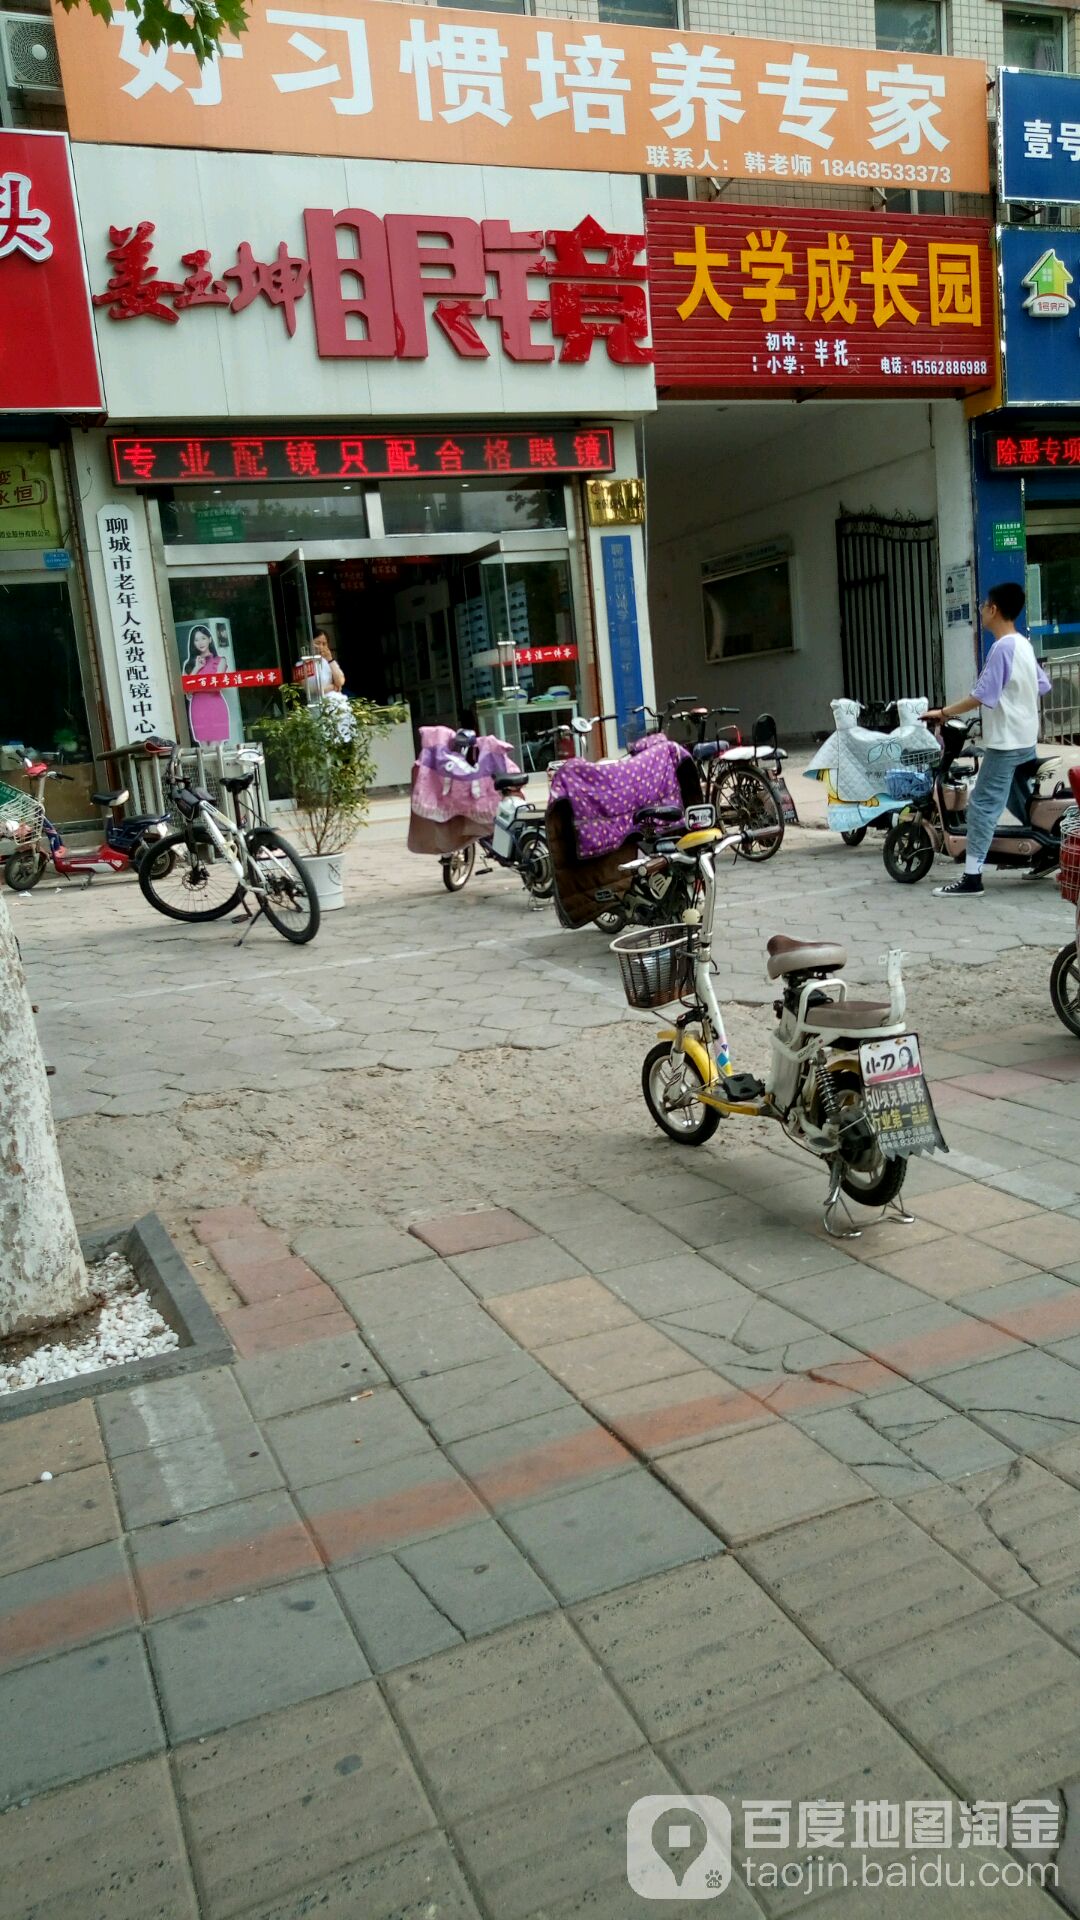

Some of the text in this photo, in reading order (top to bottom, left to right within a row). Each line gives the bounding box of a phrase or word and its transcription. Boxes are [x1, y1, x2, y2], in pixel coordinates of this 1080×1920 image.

[1024, 119, 1080, 161] 壹号
[744, 151, 812, 177] 韩老师
[820, 158, 951, 184] 18463533373
[673, 226, 982, 328] 大学成长园
[814, 338, 849, 368] 半托
[123, 435, 604, 478] 专业配镜只配合格眼镜
[996, 436, 1080, 466] 除恶专项
[105, 517, 157, 734] 聊城市老年人免费配镜中心
